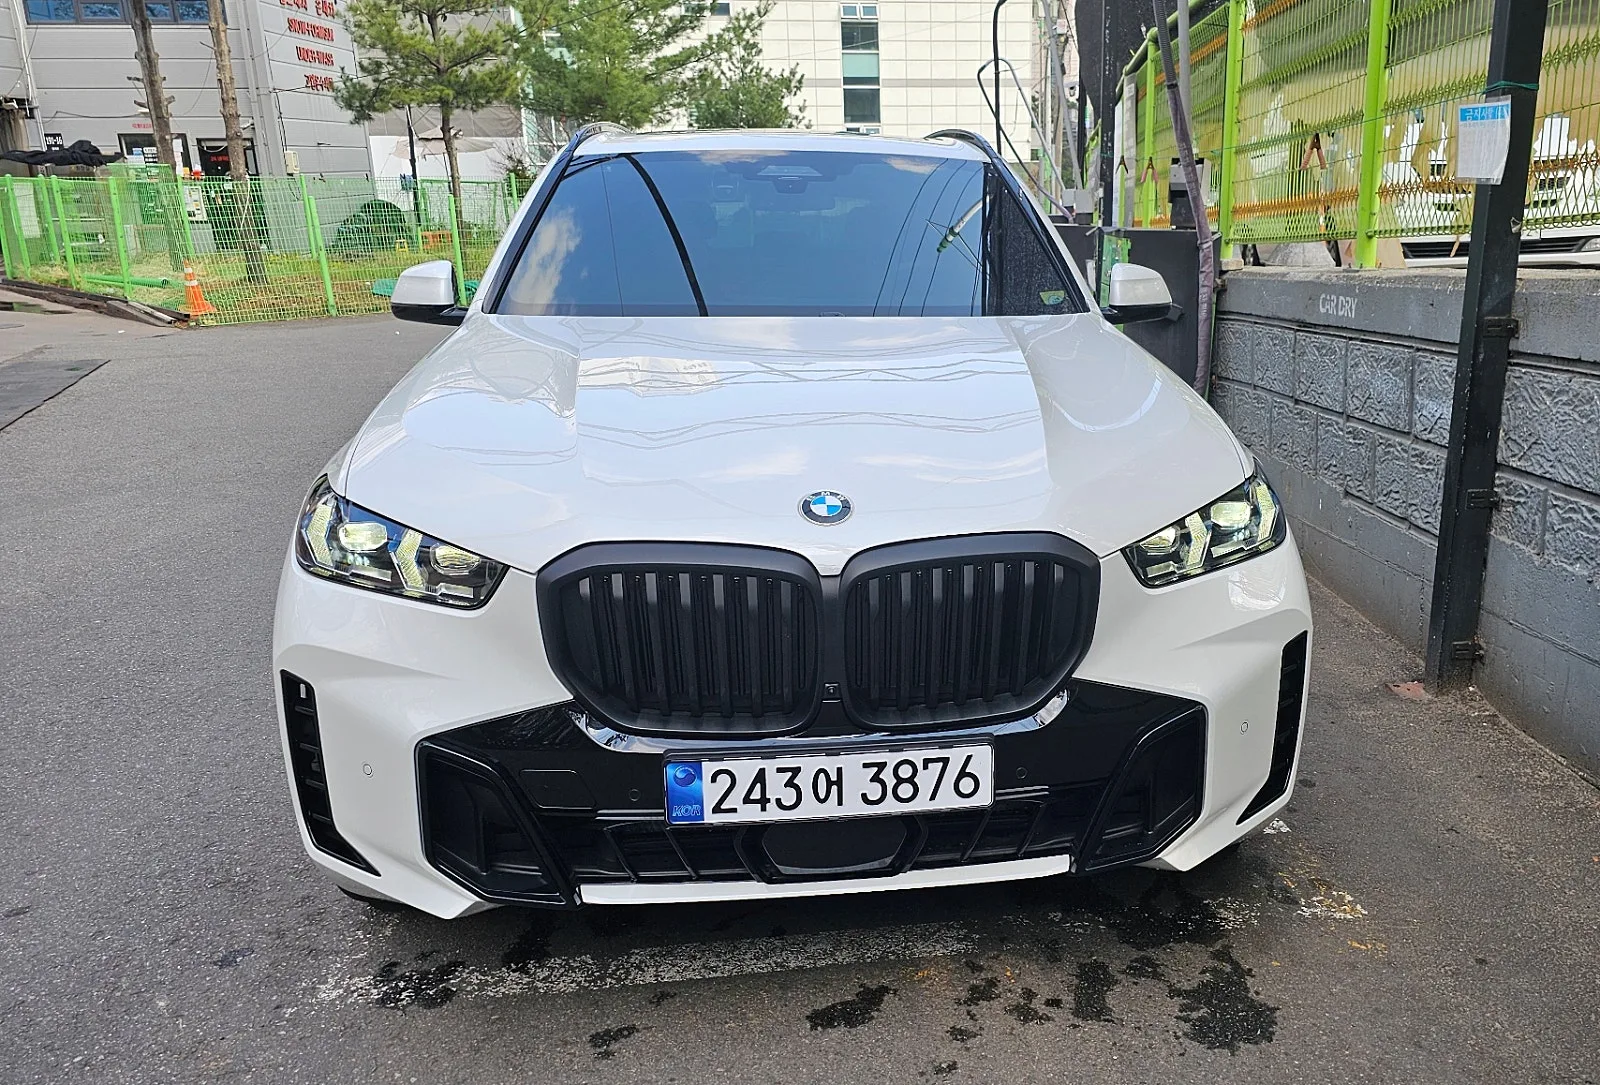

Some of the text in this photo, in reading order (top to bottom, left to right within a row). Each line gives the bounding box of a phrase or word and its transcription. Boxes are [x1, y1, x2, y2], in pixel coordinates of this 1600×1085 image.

[1319, 293, 1358, 319] CAR DRY
[710, 753, 981, 815] 243어 3876
[671, 803, 702, 818] KOR
